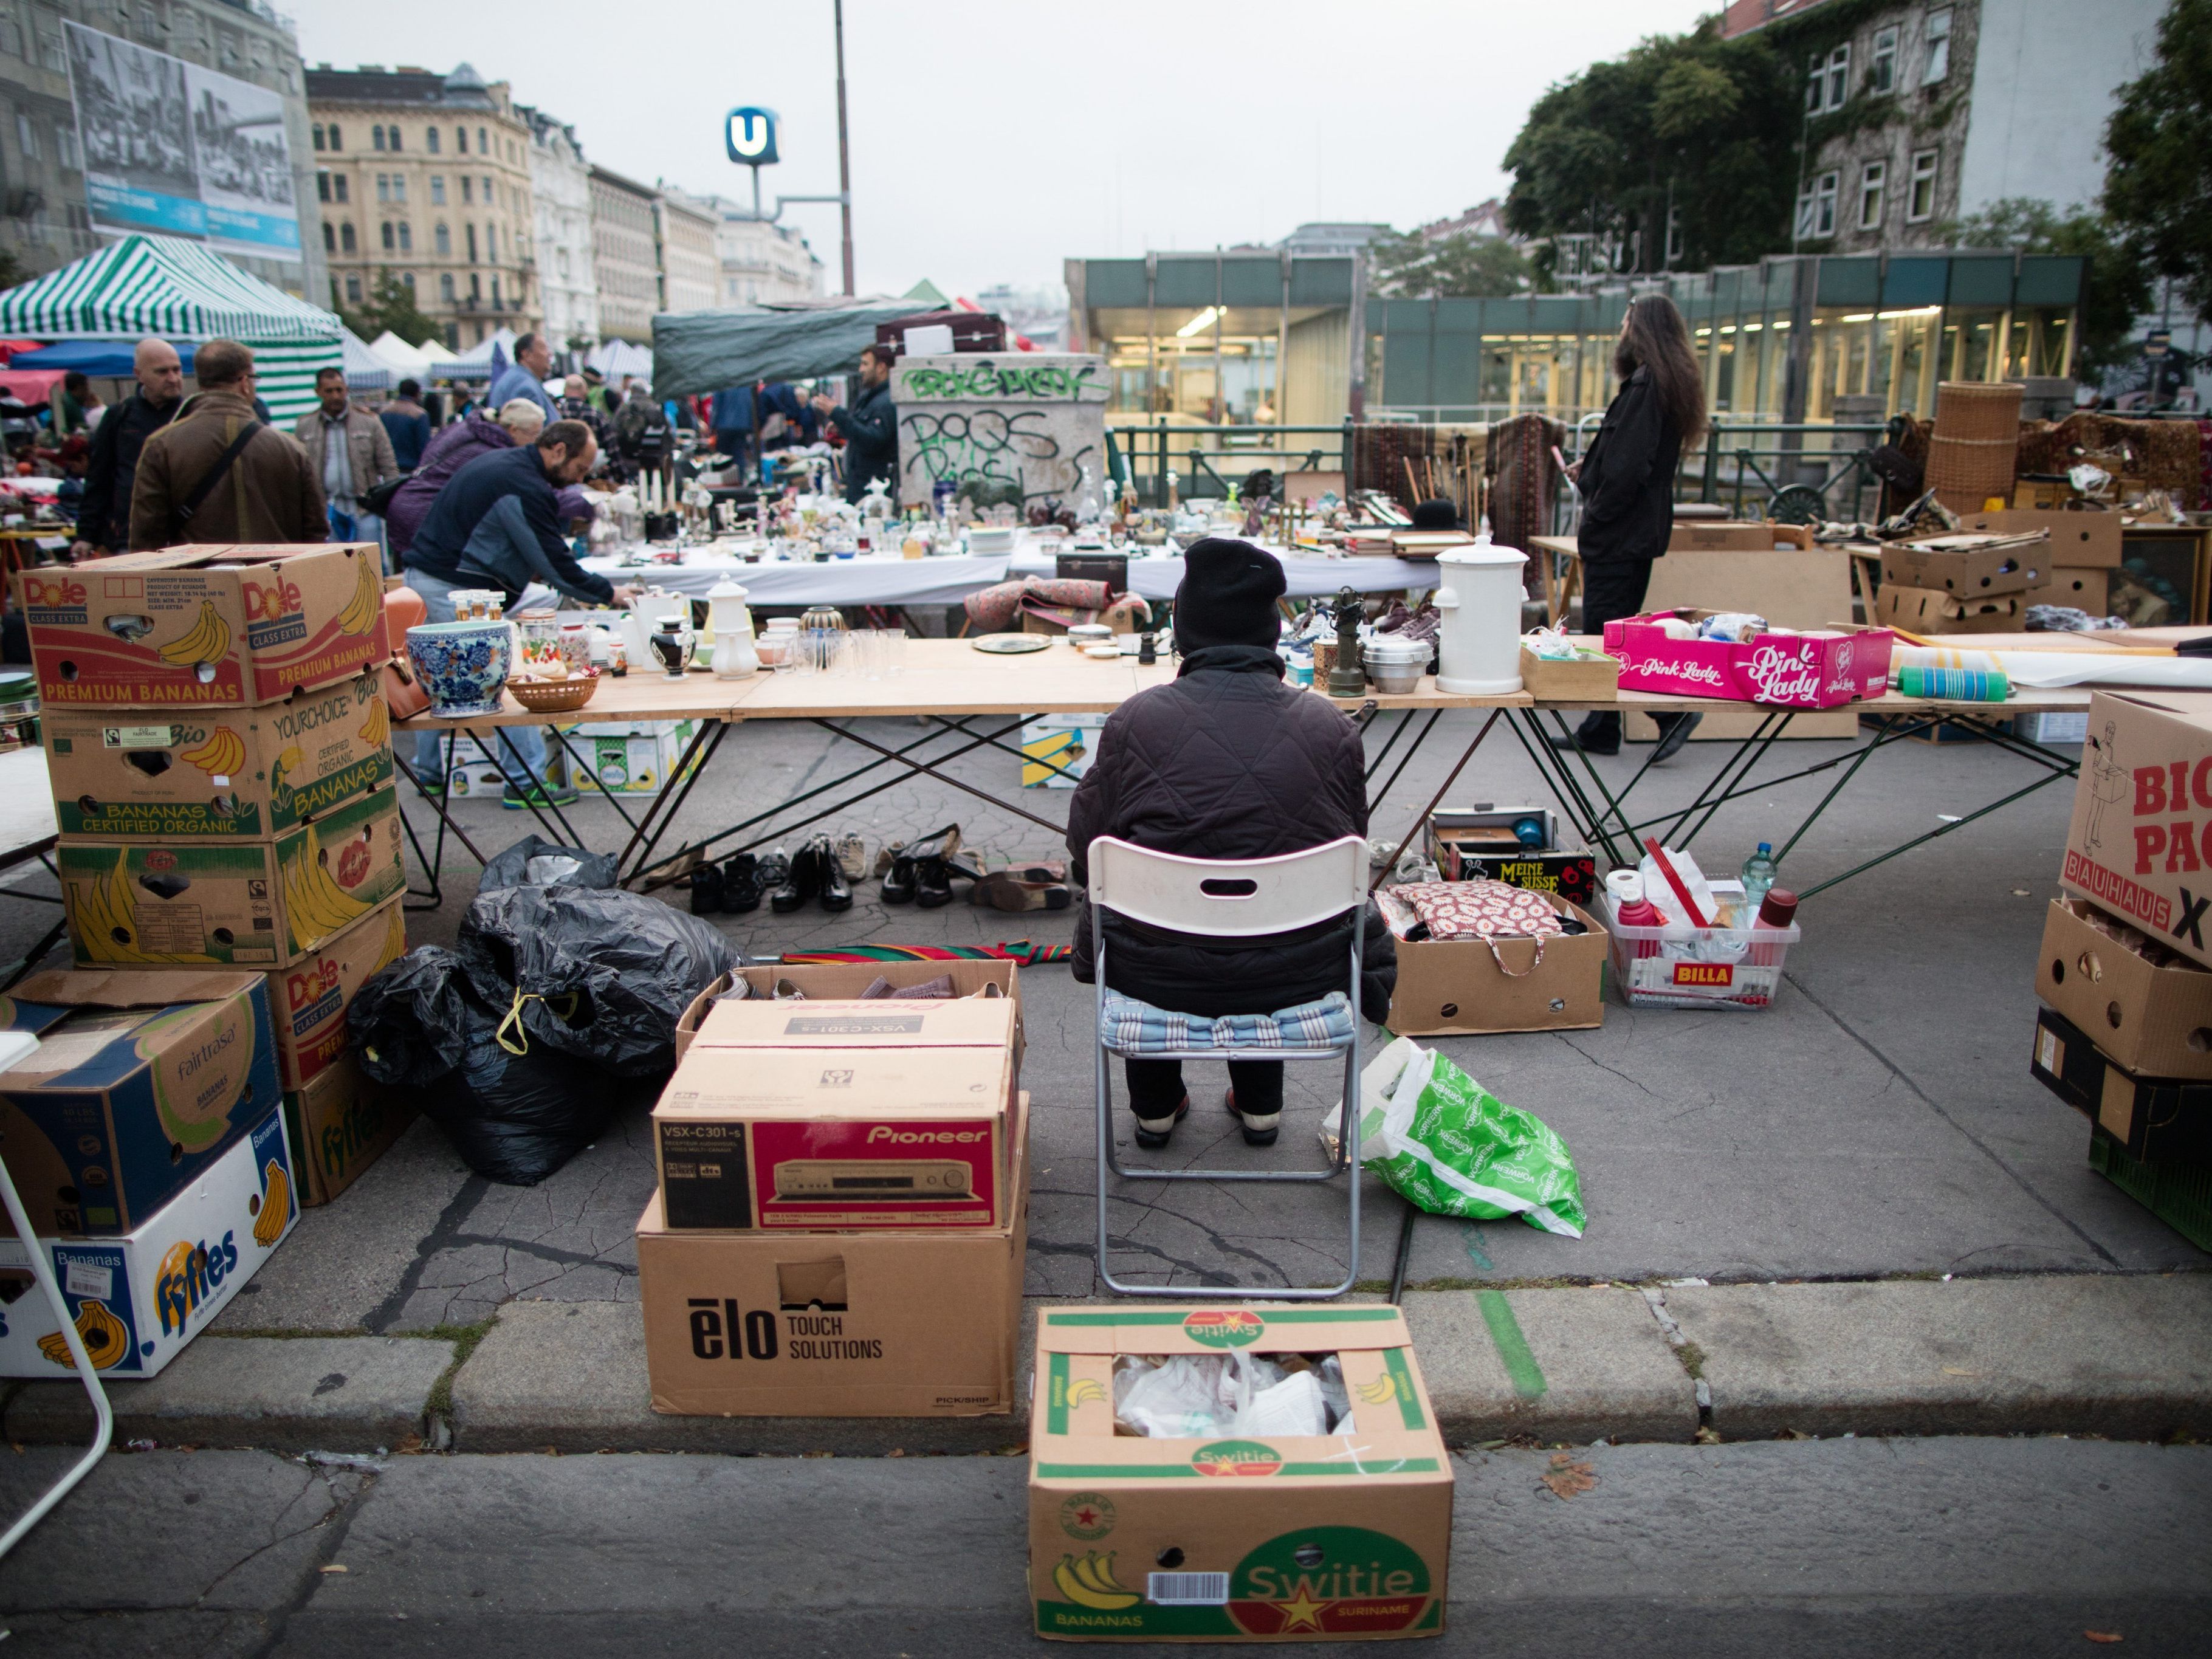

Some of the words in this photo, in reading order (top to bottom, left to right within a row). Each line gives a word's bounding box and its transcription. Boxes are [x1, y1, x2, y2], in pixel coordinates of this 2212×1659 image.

[731, 115, 768, 157] U
[24, 577, 87, 607] Dole
[242, 575, 302, 622] Dole
[252, 631, 279, 648] CLASS
[281, 627, 306, 640] EXTRA
[278, 659, 332, 685] PREMIUM
[334, 642, 376, 667] BANANAS
[1630, 658, 1680, 676] Pink
[1679, 661, 1724, 686] Lady
[1734, 643, 1815, 679] Pink
[46, 684, 137, 700] PREMIUM
[140, 684, 238, 700] BANANAS
[355, 676, 378, 706] Bio
[1754, 670, 1819, 703] Lady
[167, 724, 205, 748] Bio
[318, 738, 350, 760] CERTIFIED
[317, 750, 354, 777] ORGANIC
[294, 760, 378, 817] BANANAS
[106, 805, 206, 818] BANANAS
[83, 819, 159, 833] CERTIFIED
[169, 820, 237, 833] ORGANIC
[1500, 862, 1544, 882] MEINE
[2066, 853, 2169, 926] BAUHAUS
[287, 957, 338, 1012] Dole
[1677, 967, 1728, 983] BILLA
[296, 1014, 318, 1034] CLASS
[320, 998, 342, 1022] EXTRA
[196, 1074, 228, 1106] BANANAS
[1429, 1077, 1466, 1107] VORWERK
[1418, 1103, 1444, 1141] VORWERK
[1461, 1092, 1485, 1131] VORWERK
[253, 1118, 280, 1149] Bananas
[867, 1125, 988, 1144] Pioneer
[1437, 1128, 1474, 1155] VORWERK
[1468, 1141, 1498, 1180] VORWERK
[1490, 1161, 1535, 1184] VORWERK
[1410, 1180, 1443, 1209] VORWERK
[1539, 1167, 1559, 1206] VORWERK
[58, 1252, 121, 1266] Bananas
[788, 1316, 843, 1336] TOUCH
[1190, 1326, 1257, 1339] Switie
[790, 1339, 884, 1360] SOLUTIONS
[1200, 1450, 1276, 1463] Switie
[1248, 1564, 1415, 1599] Switie
[1056, 1613, 1143, 1627] BANANAS
[1338, 1604, 1410, 1618] SURINAME
